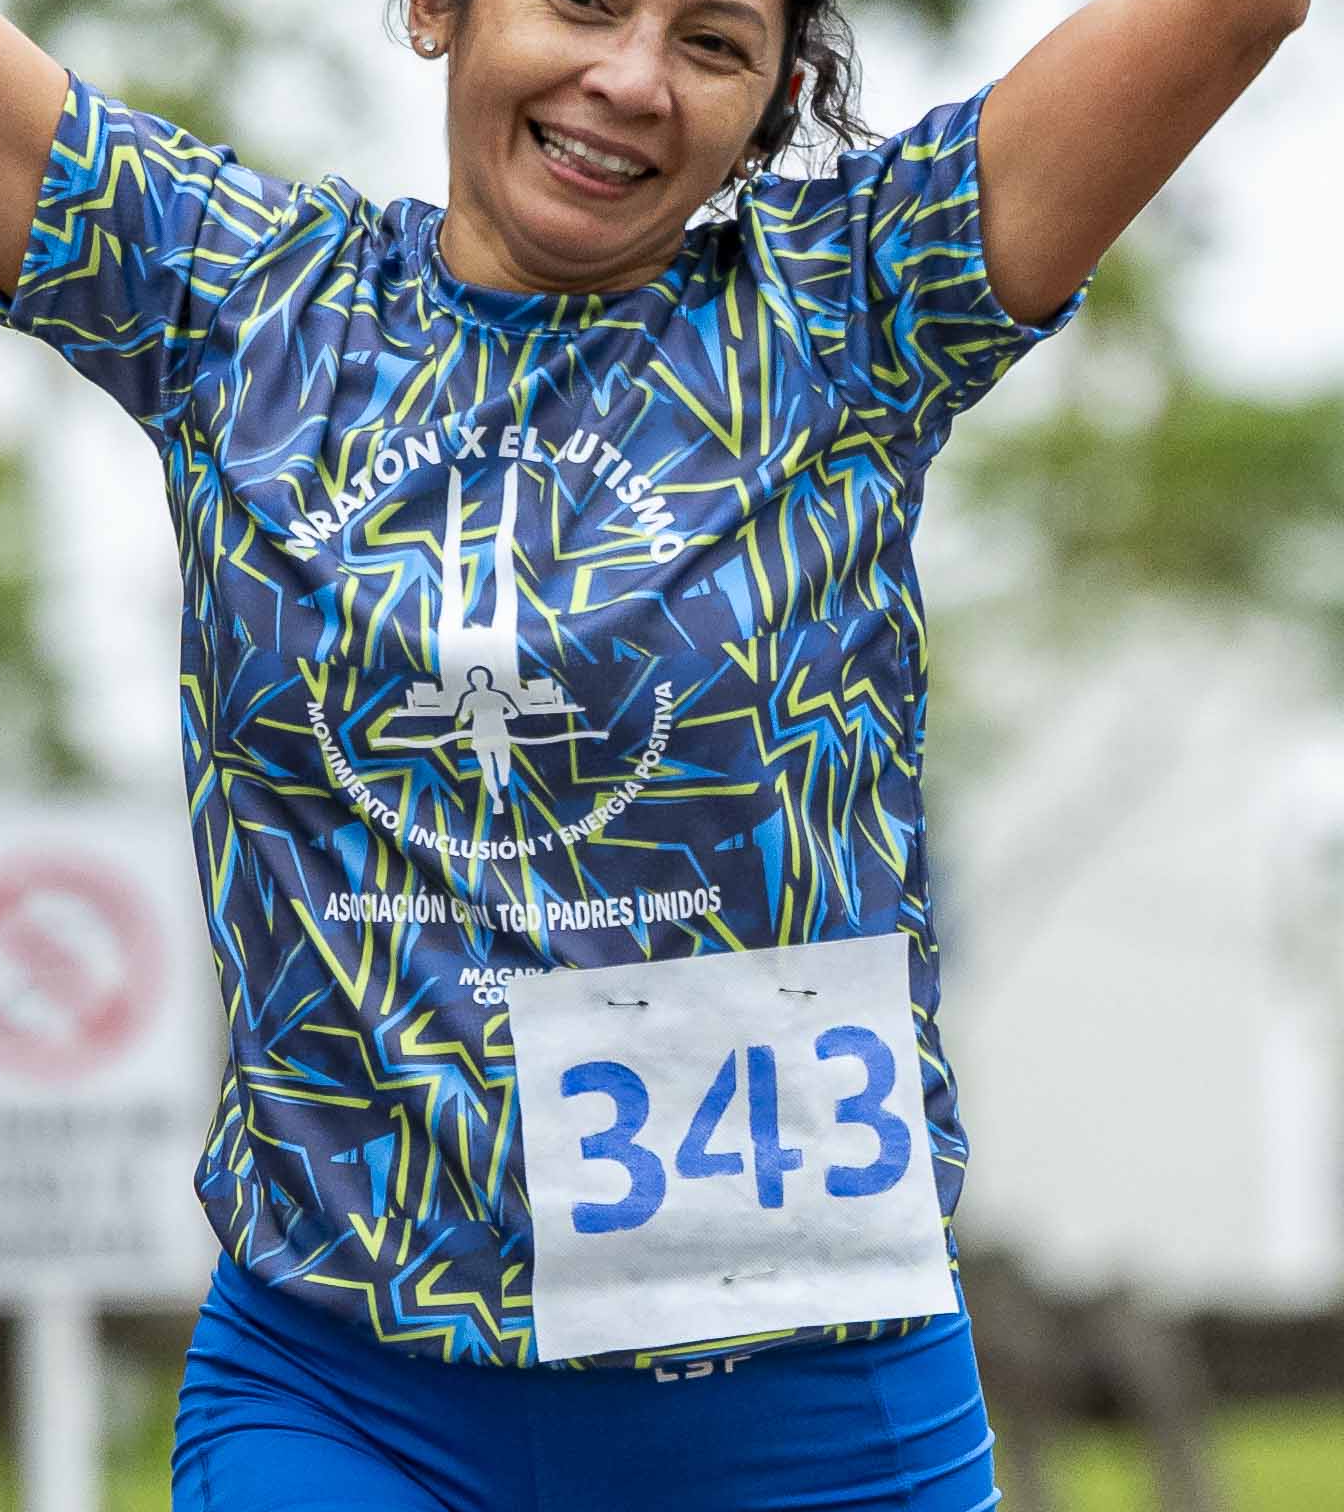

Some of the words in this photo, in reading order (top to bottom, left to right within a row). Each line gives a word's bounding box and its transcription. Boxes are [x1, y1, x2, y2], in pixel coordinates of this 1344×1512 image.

[456, 426, 487, 459] X
[498, 425, 543, 463] EL
[306, 701, 402, 836] MOVIMIENTO,
[408, 825, 536, 860] INCLUSIÓN
[536, 833, 553, 853] Y
[559, 781, 643, 845] ENERGÍA
[635, 681, 673, 780] POSITIVA
[324, 888, 445, 924] ASOCIACIÓN
[496, 905, 542, 933] TGD
[548, 896, 634, 931] PADRES
[640, 886, 722, 922] UNIDOS
[559, 1025, 911, 1234] 343
